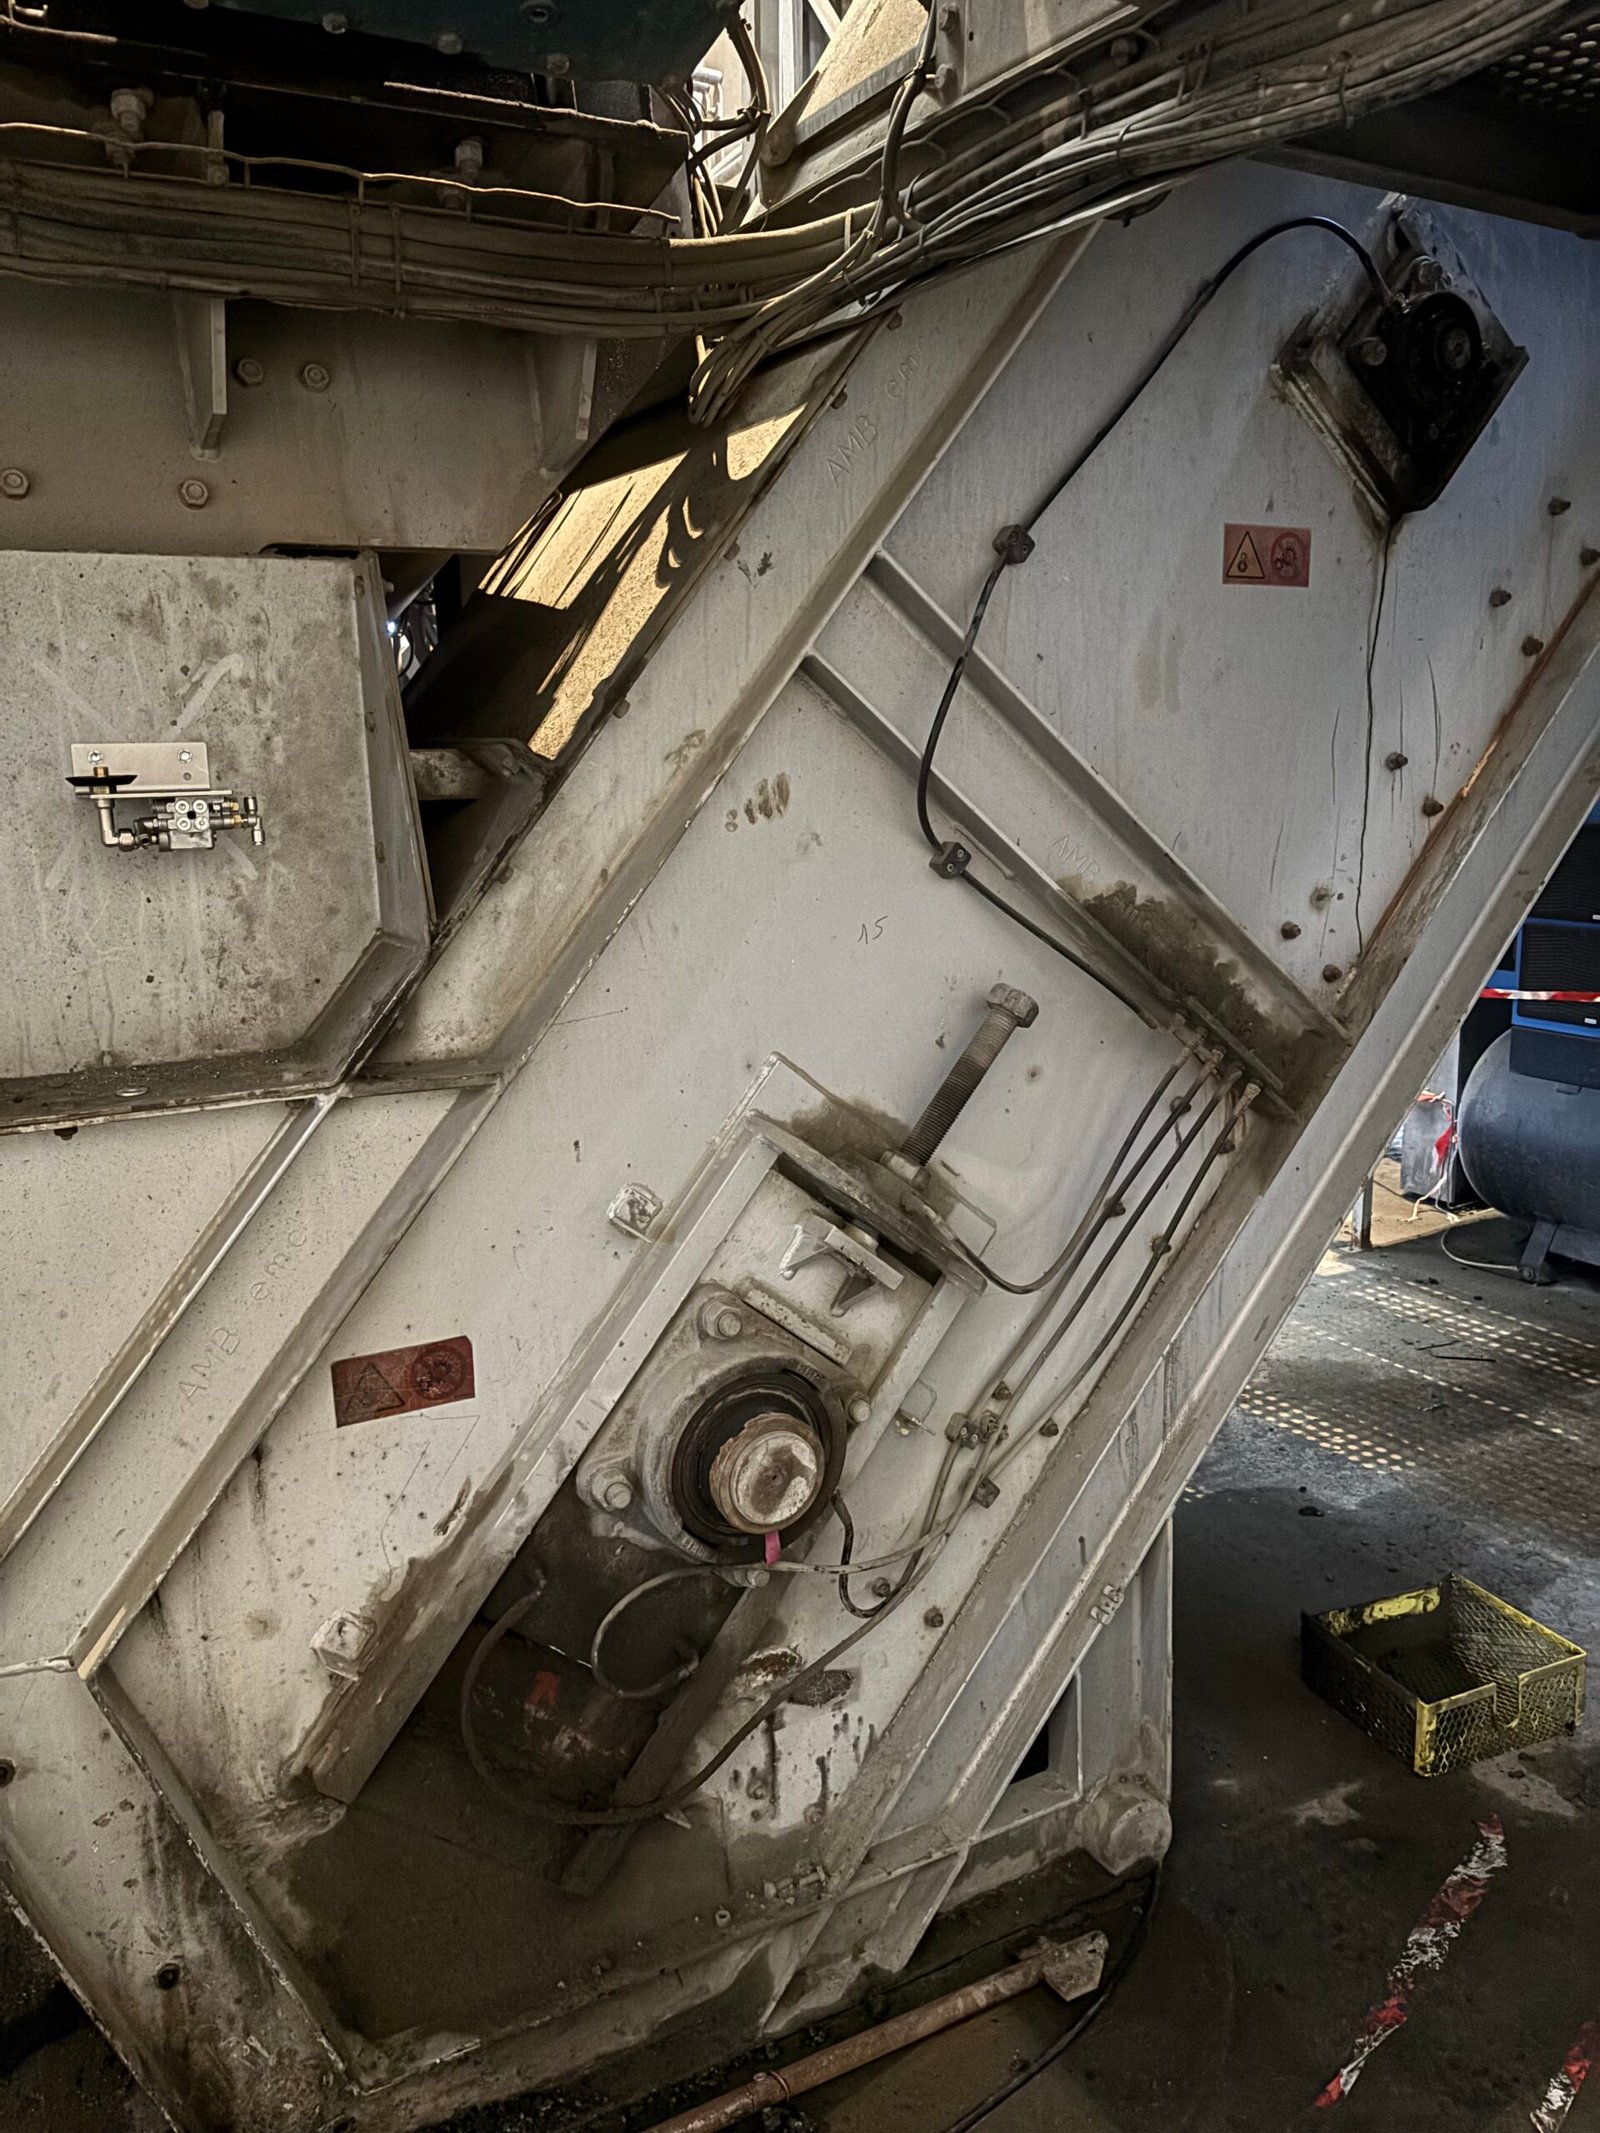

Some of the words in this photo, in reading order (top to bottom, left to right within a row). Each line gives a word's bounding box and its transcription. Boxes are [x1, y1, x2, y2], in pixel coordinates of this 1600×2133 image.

[826, 414, 878, 487] AMB
[1049, 833, 1101, 883] AMB
[857, 915, 888, 945] 15
[177, 1326, 241, 1399] AMB
